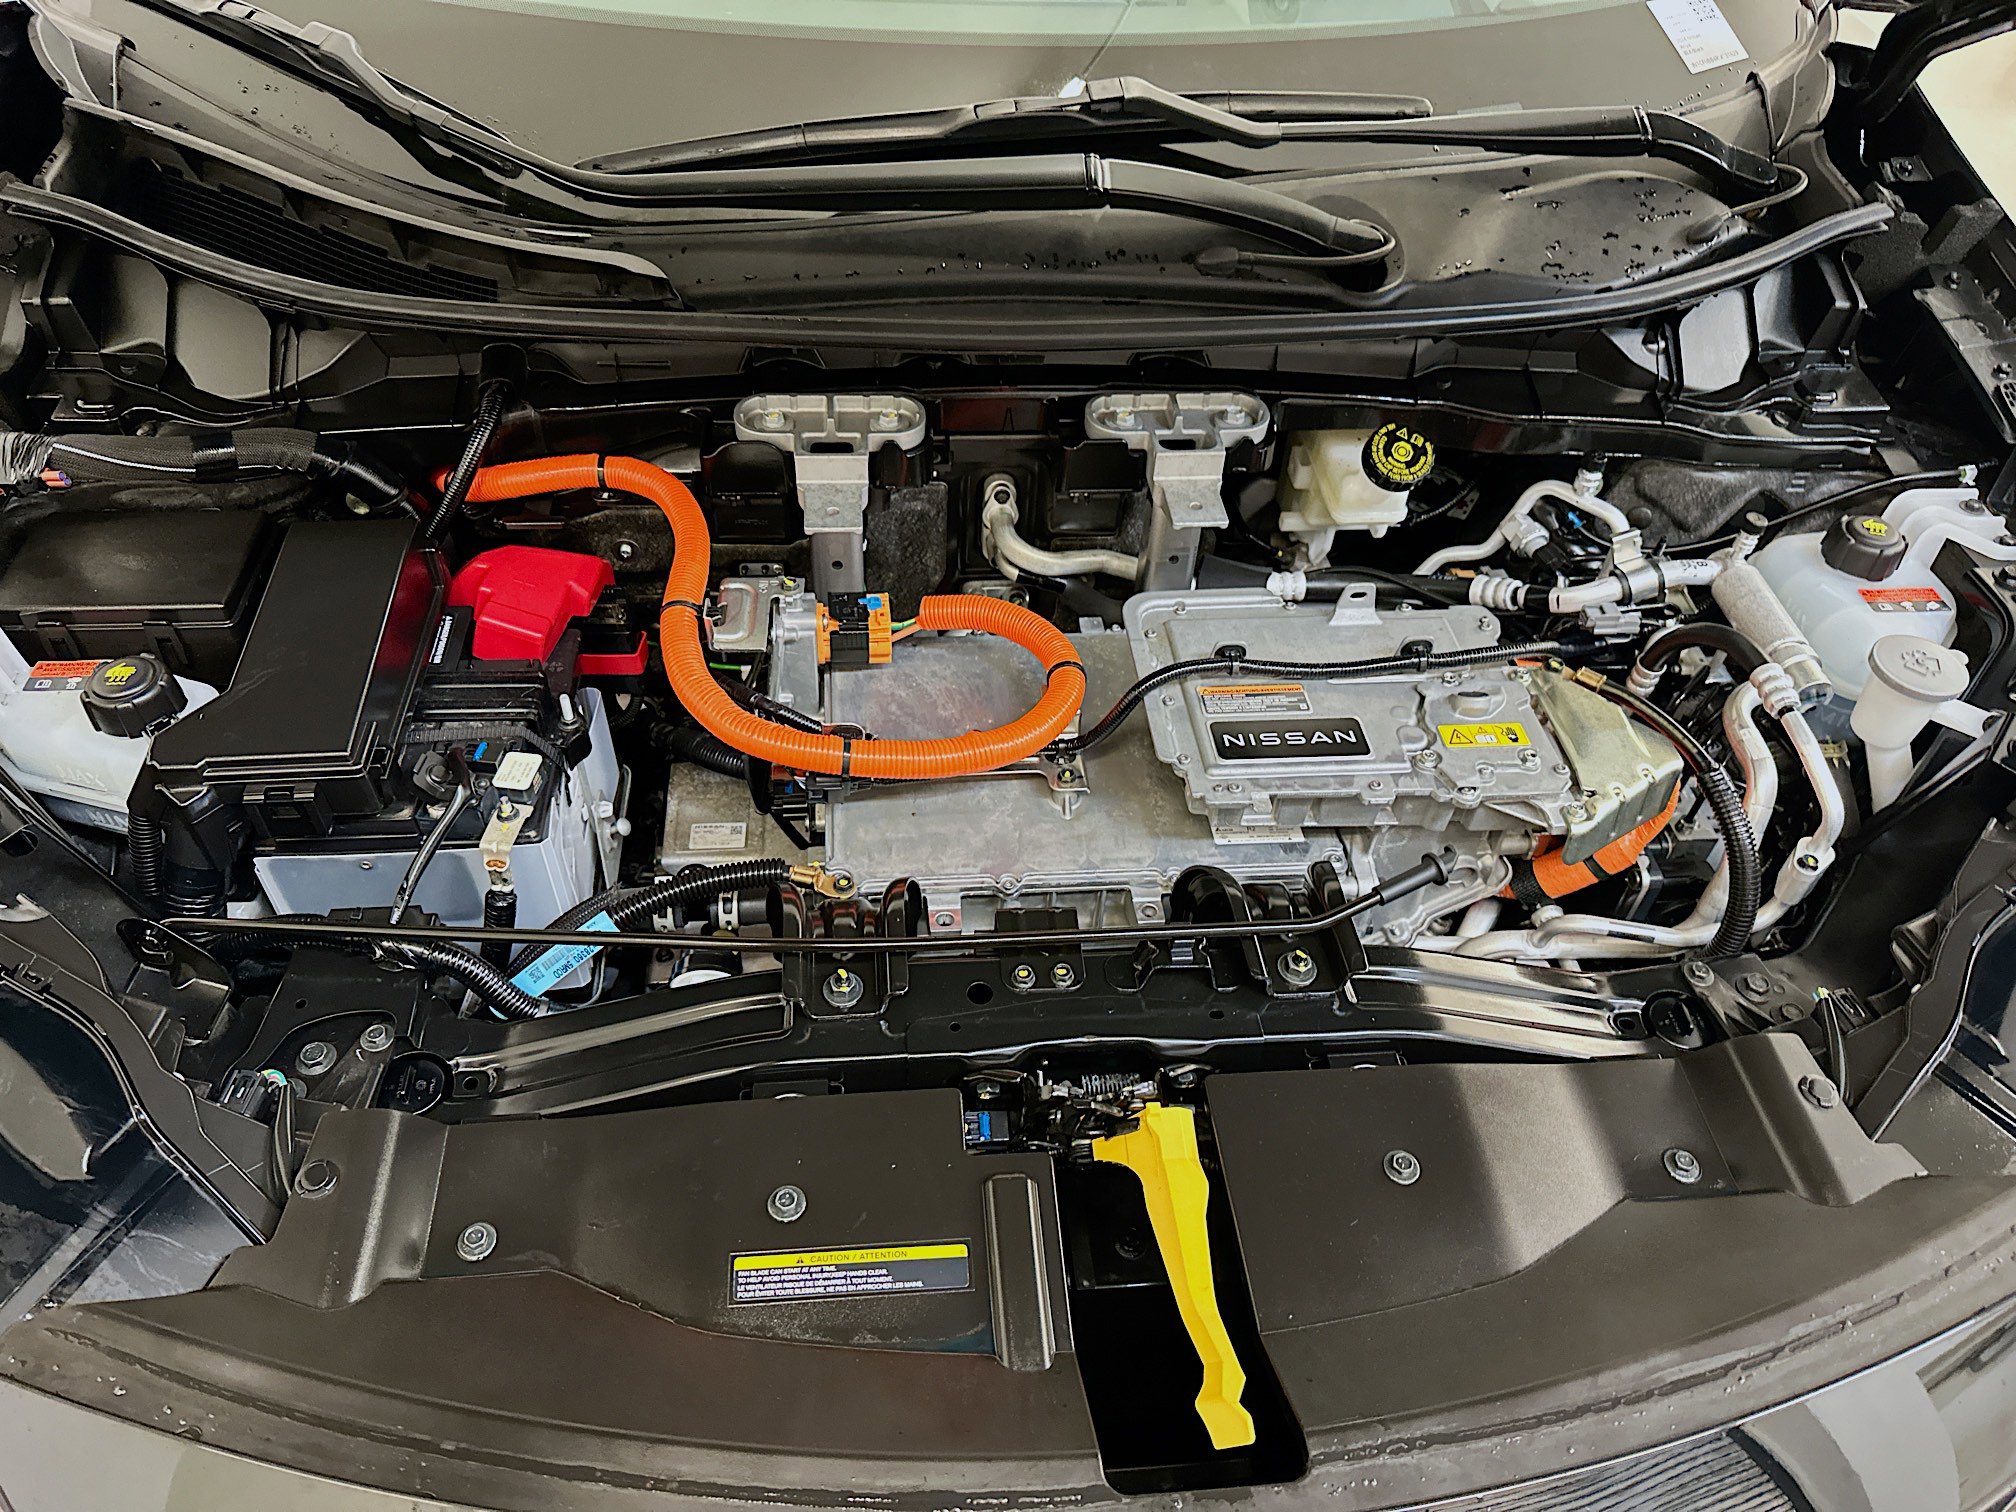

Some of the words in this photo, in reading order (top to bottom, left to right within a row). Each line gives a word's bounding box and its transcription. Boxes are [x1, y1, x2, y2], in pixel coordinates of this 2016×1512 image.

[1222, 730, 1358, 747] NISSAN
[810, 1254, 849, 1263] CAUTION
[859, 1250, 906, 1260] ATTENTION
